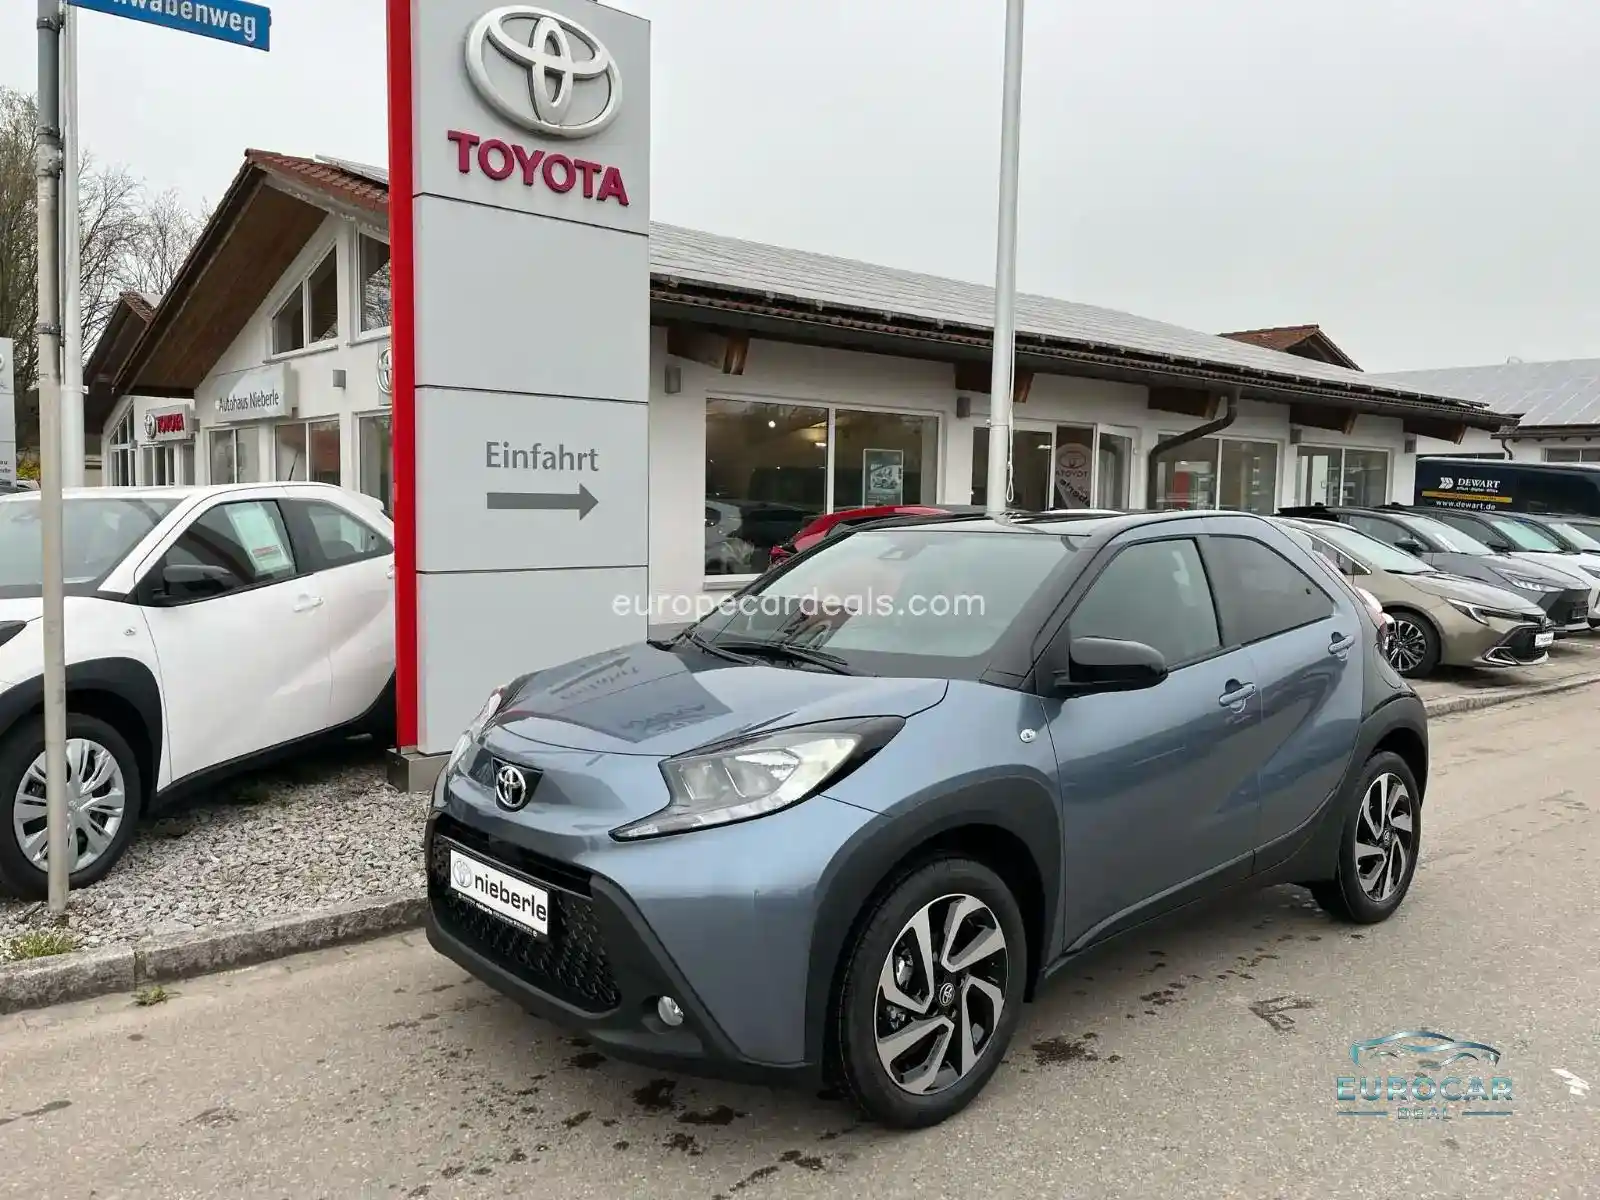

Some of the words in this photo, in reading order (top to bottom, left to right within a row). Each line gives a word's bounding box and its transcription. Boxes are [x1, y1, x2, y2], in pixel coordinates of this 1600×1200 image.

[113, 0, 256, 41] wabenweg
[448, 130, 629, 206] TOYOTA
[218, 394, 248, 414] Autohaus
[249, 389, 279, 409] Nieberle
[486, 441, 599, 471] Einfahrt
[1457, 478, 1500, 488] DEWART
[1436, 500, 1496, 510] www.dewart.de
[475, 874, 547, 922] nieberle
